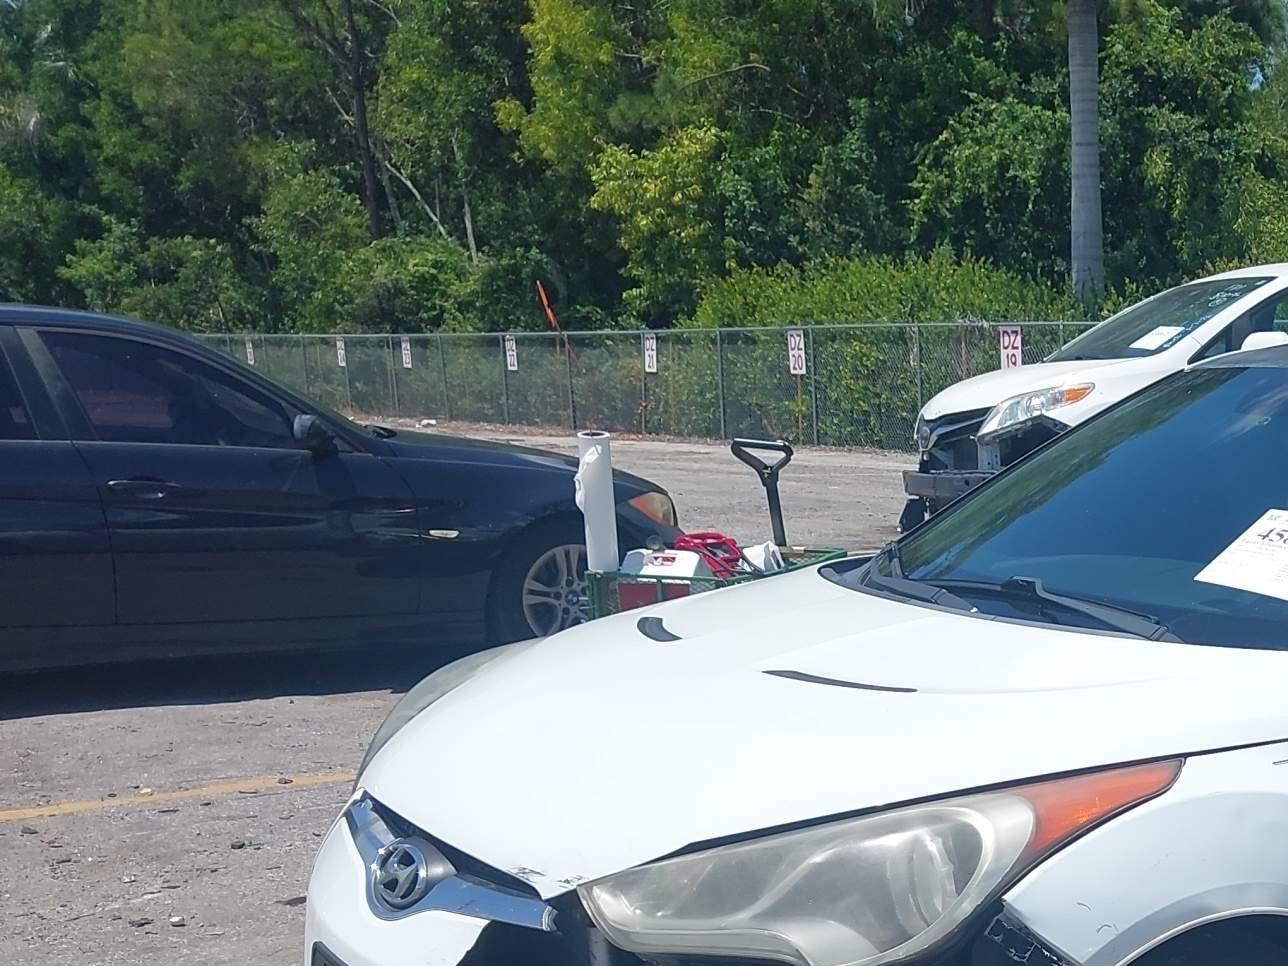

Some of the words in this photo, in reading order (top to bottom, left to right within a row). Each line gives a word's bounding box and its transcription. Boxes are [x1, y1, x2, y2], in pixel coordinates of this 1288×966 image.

[645, 336, 655, 352] DZ
[789, 334, 803, 351] DZ
[1002, 330, 1020, 350] DZ
[792, 354, 804, 371] 20
